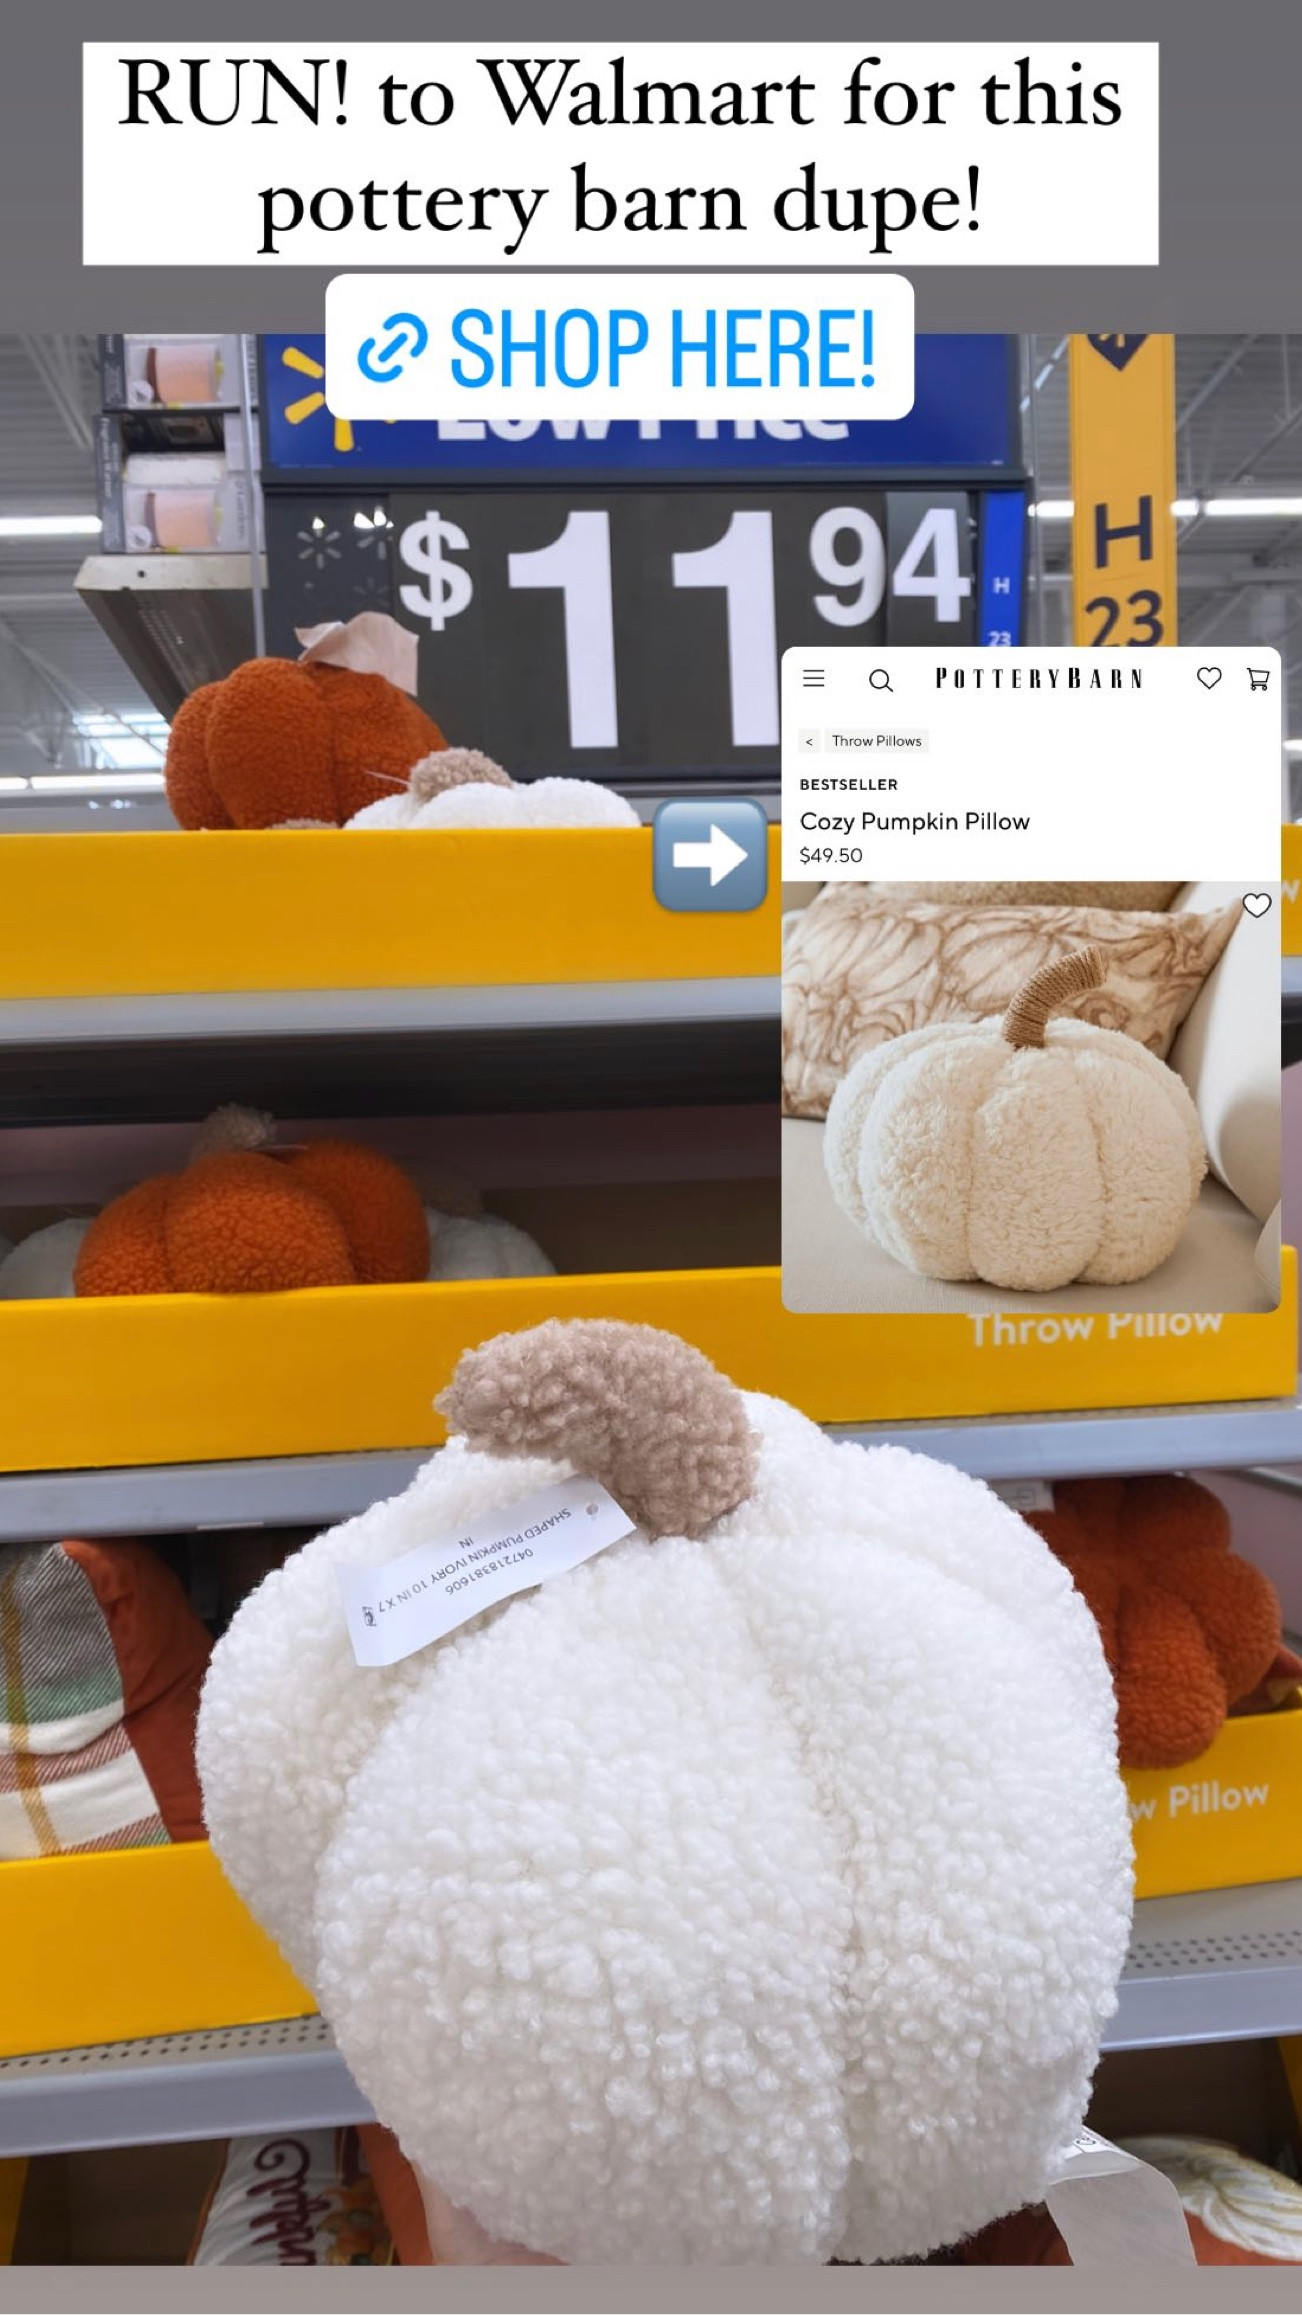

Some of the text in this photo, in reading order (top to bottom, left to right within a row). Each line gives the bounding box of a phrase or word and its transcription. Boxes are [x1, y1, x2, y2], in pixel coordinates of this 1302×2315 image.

[1095, 495, 1153, 569] H
[993, 578, 1010, 594] H
[1085, 589, 1164, 647] 23
[989, 631, 1011, 647] 23
[966, 1313, 1224, 1347] Throw Pillow
[524, 1508, 572, 1539] SHAPED
[468, 1534, 525, 1563] PUMPKIN
[430, 1556, 469, 1585] IVORY
[1168, 1780, 1270, 1819] Pillow
